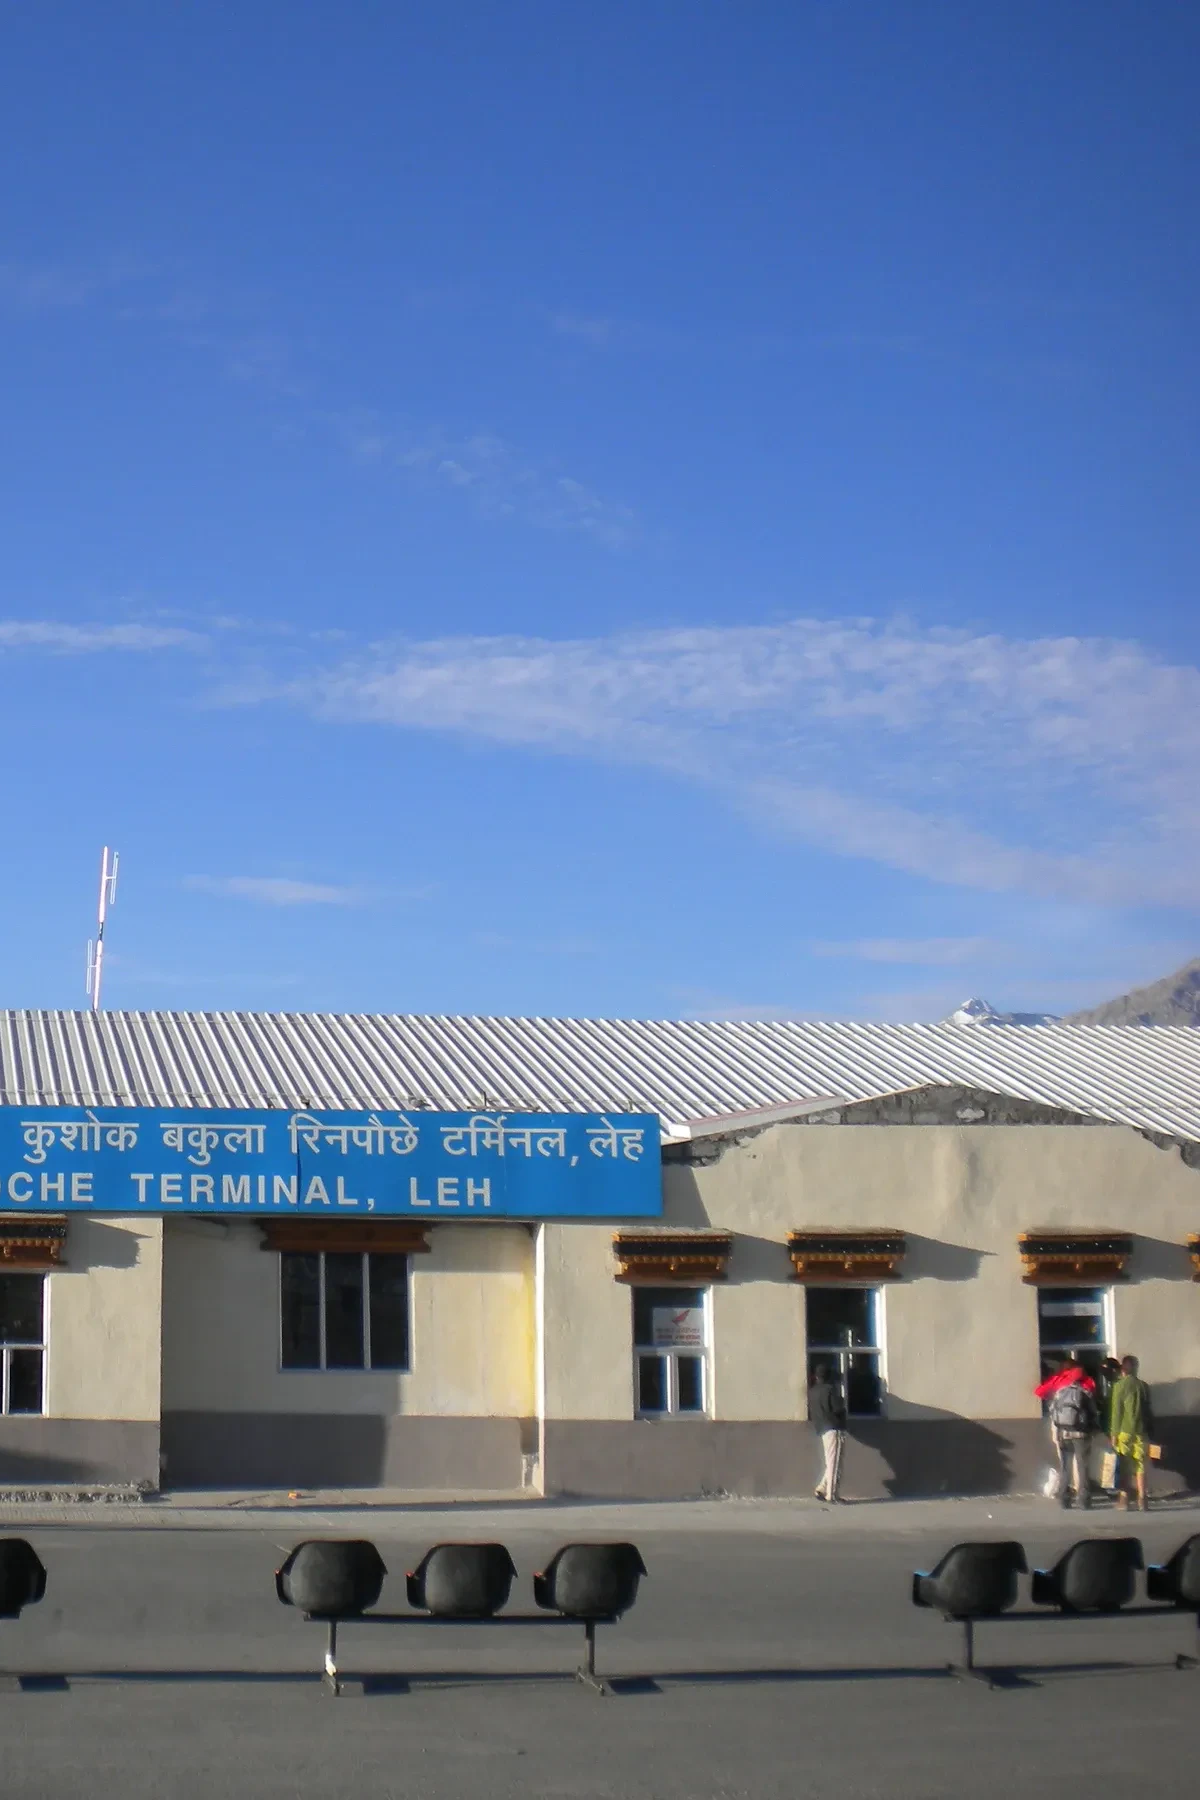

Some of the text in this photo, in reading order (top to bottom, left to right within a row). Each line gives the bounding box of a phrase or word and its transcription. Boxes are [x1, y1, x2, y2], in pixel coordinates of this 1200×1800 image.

[20, 1109, 140, 1165] कुशोक
[160, 1122, 267, 1167] बकुला
[440, 1115, 579, 1167] टर्मिनल,
[586, 1116, 645, 1162] लेह
[130, 1173, 376, 1212] TERMINAL,
[409, 1176, 493, 1207] LEH
